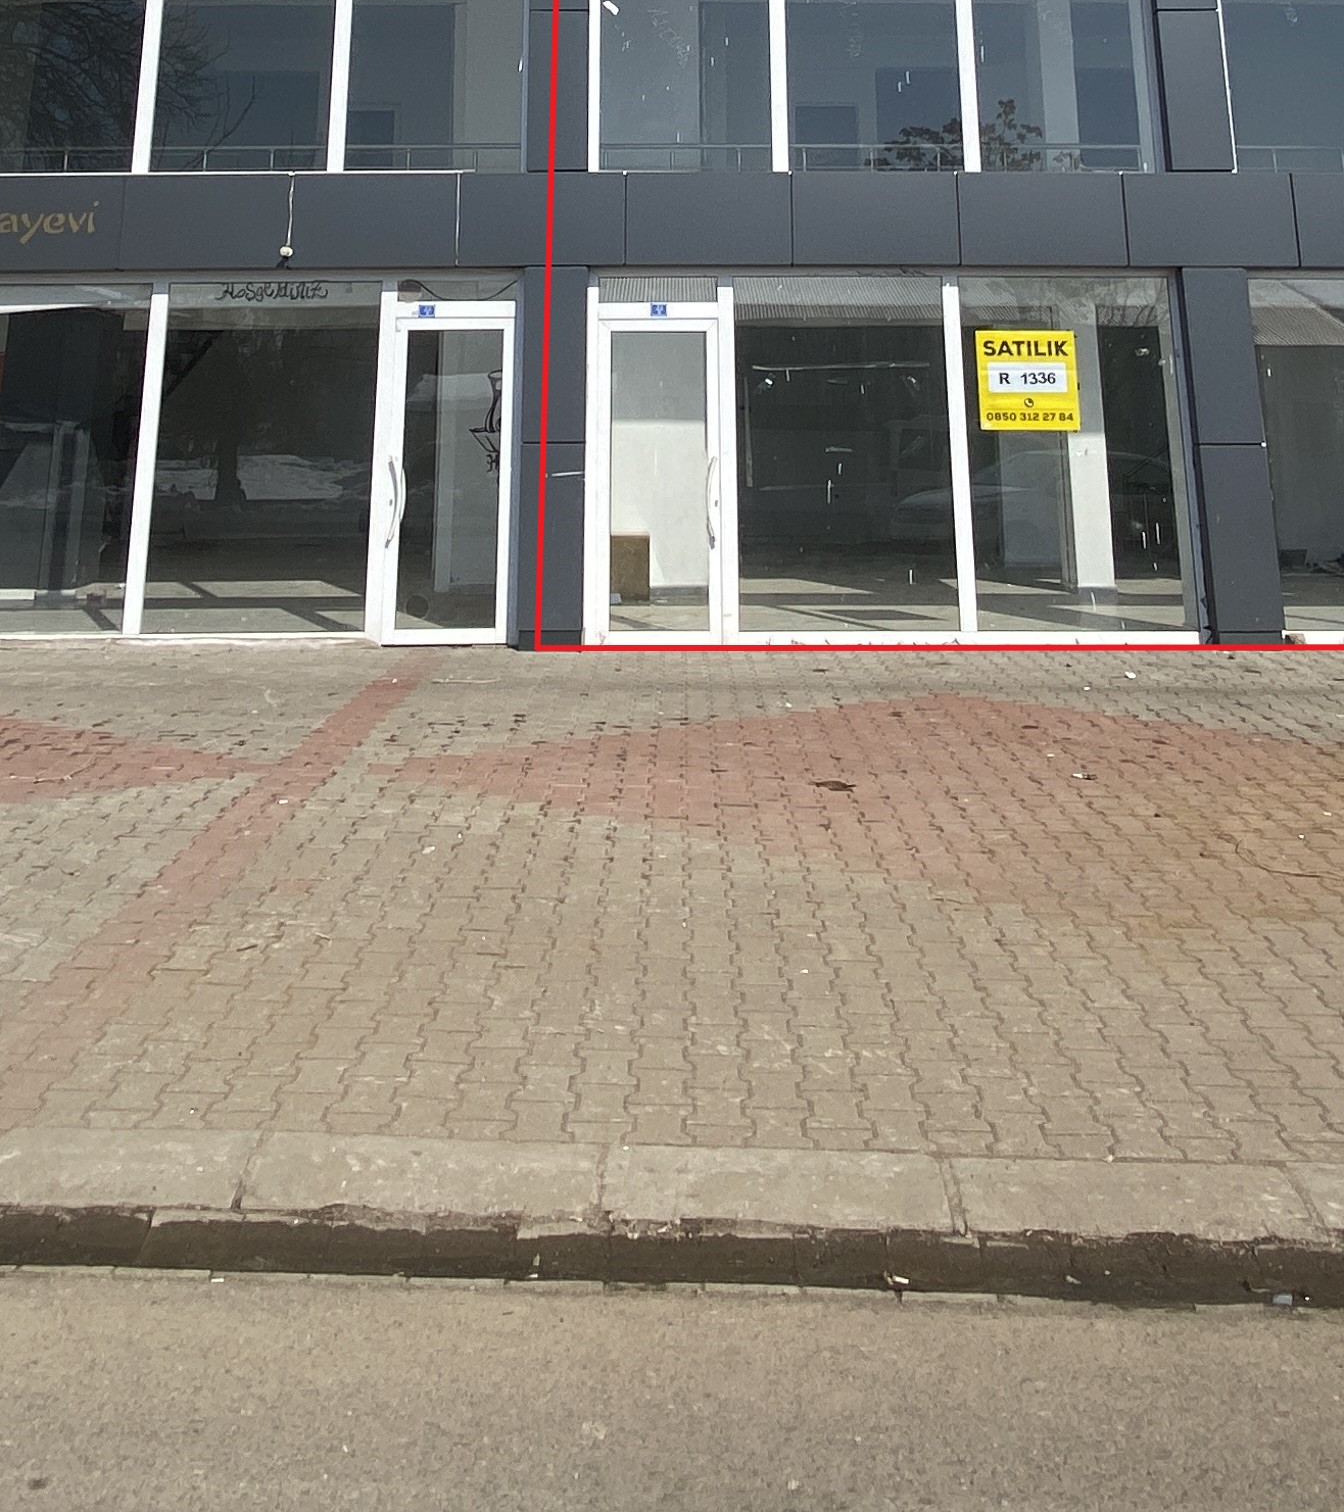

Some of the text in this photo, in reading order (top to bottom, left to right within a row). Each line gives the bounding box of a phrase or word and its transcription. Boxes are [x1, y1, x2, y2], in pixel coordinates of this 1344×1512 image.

[982, 340, 1069, 357] SATILIK
[999, 372, 1056, 385] R 1336
[986, 412, 1074, 422] 0850 312 27 84
